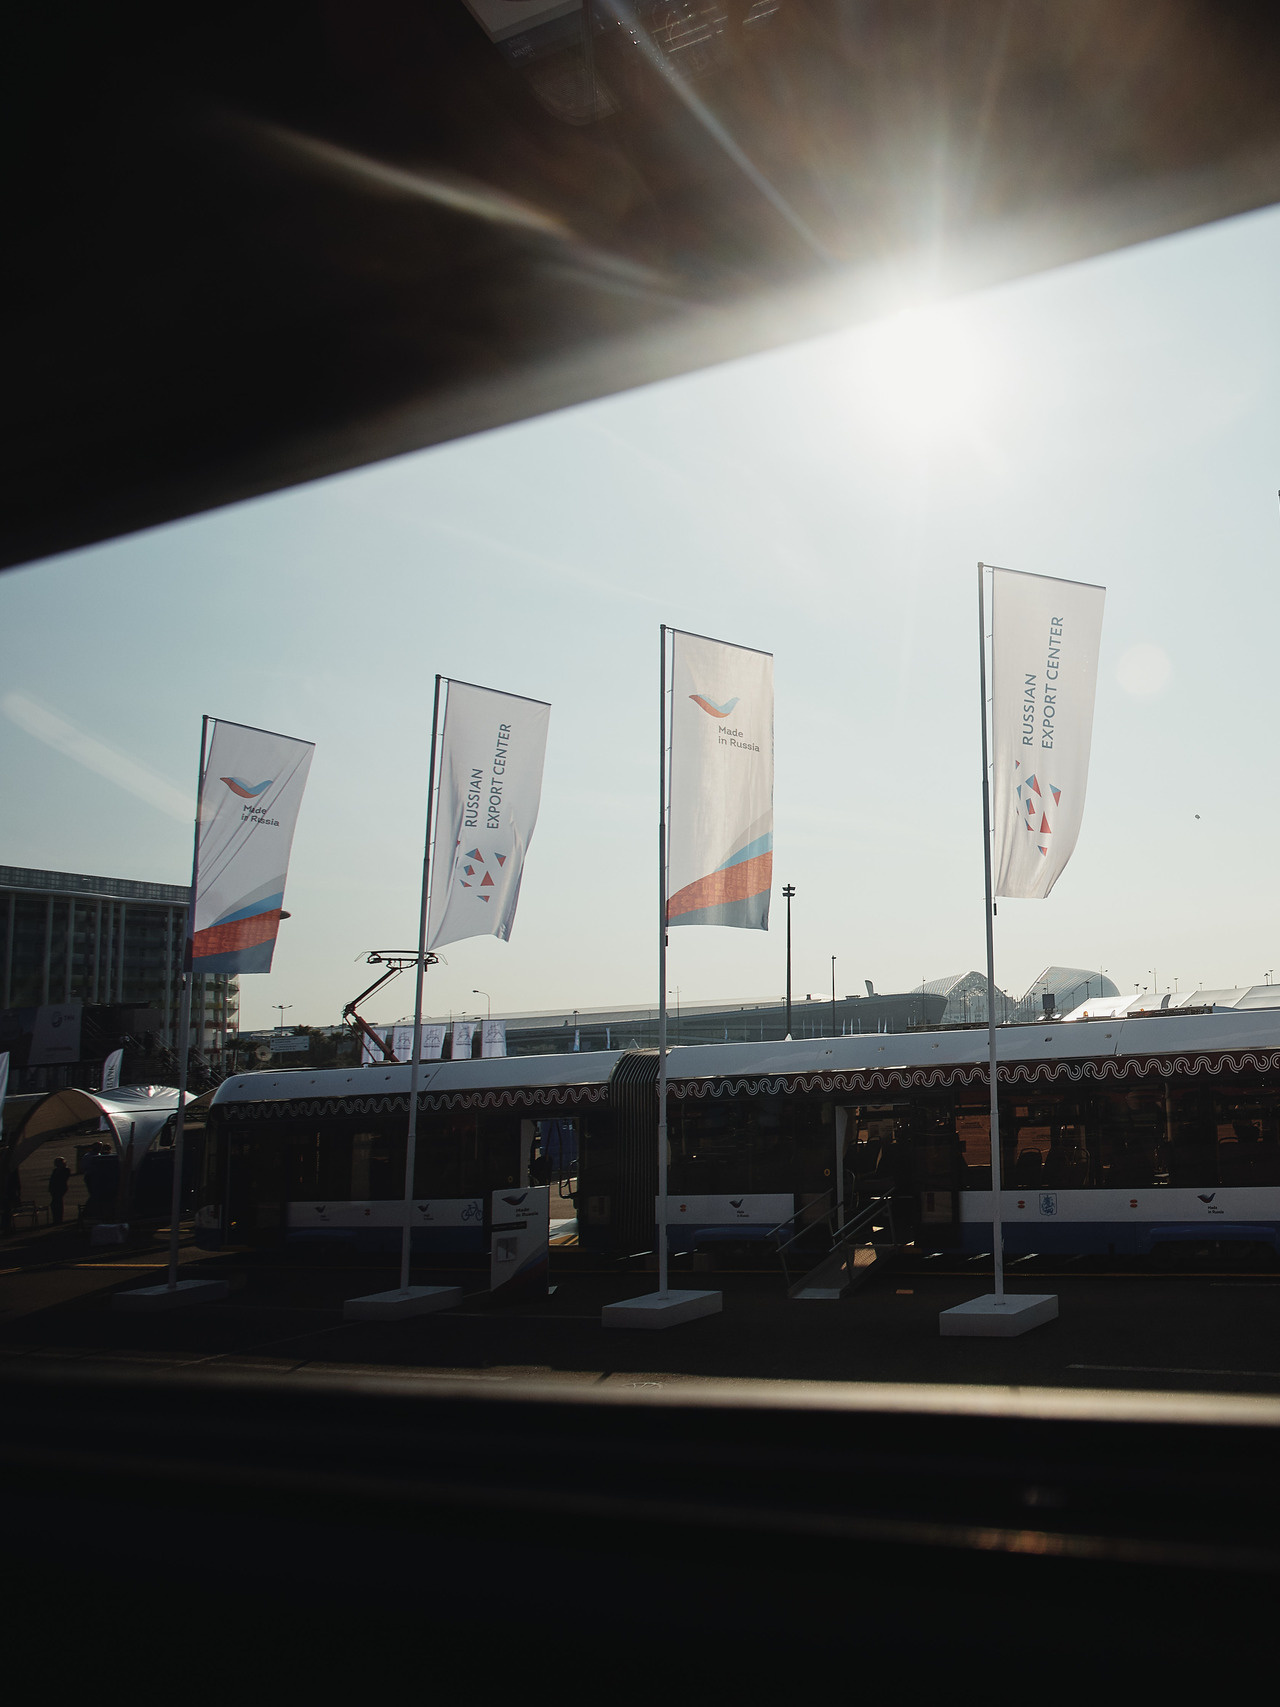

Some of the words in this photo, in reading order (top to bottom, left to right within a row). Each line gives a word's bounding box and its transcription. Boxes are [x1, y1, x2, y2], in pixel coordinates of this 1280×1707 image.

[1046, 616, 1064, 680] CENTER
[718, 725, 744, 738] Made
[1022, 673, 1037, 746] RUSSIAN
[1041, 683, 1057, 749] EXPORT
[492, 723, 511, 776] CENTER
[718, 736, 727, 745] in
[730, 738, 760, 753] Russia
[243, 804, 268, 815] Made
[464, 768, 483, 828] RUSSIAN
[486, 777, 503, 829] EXPORT
